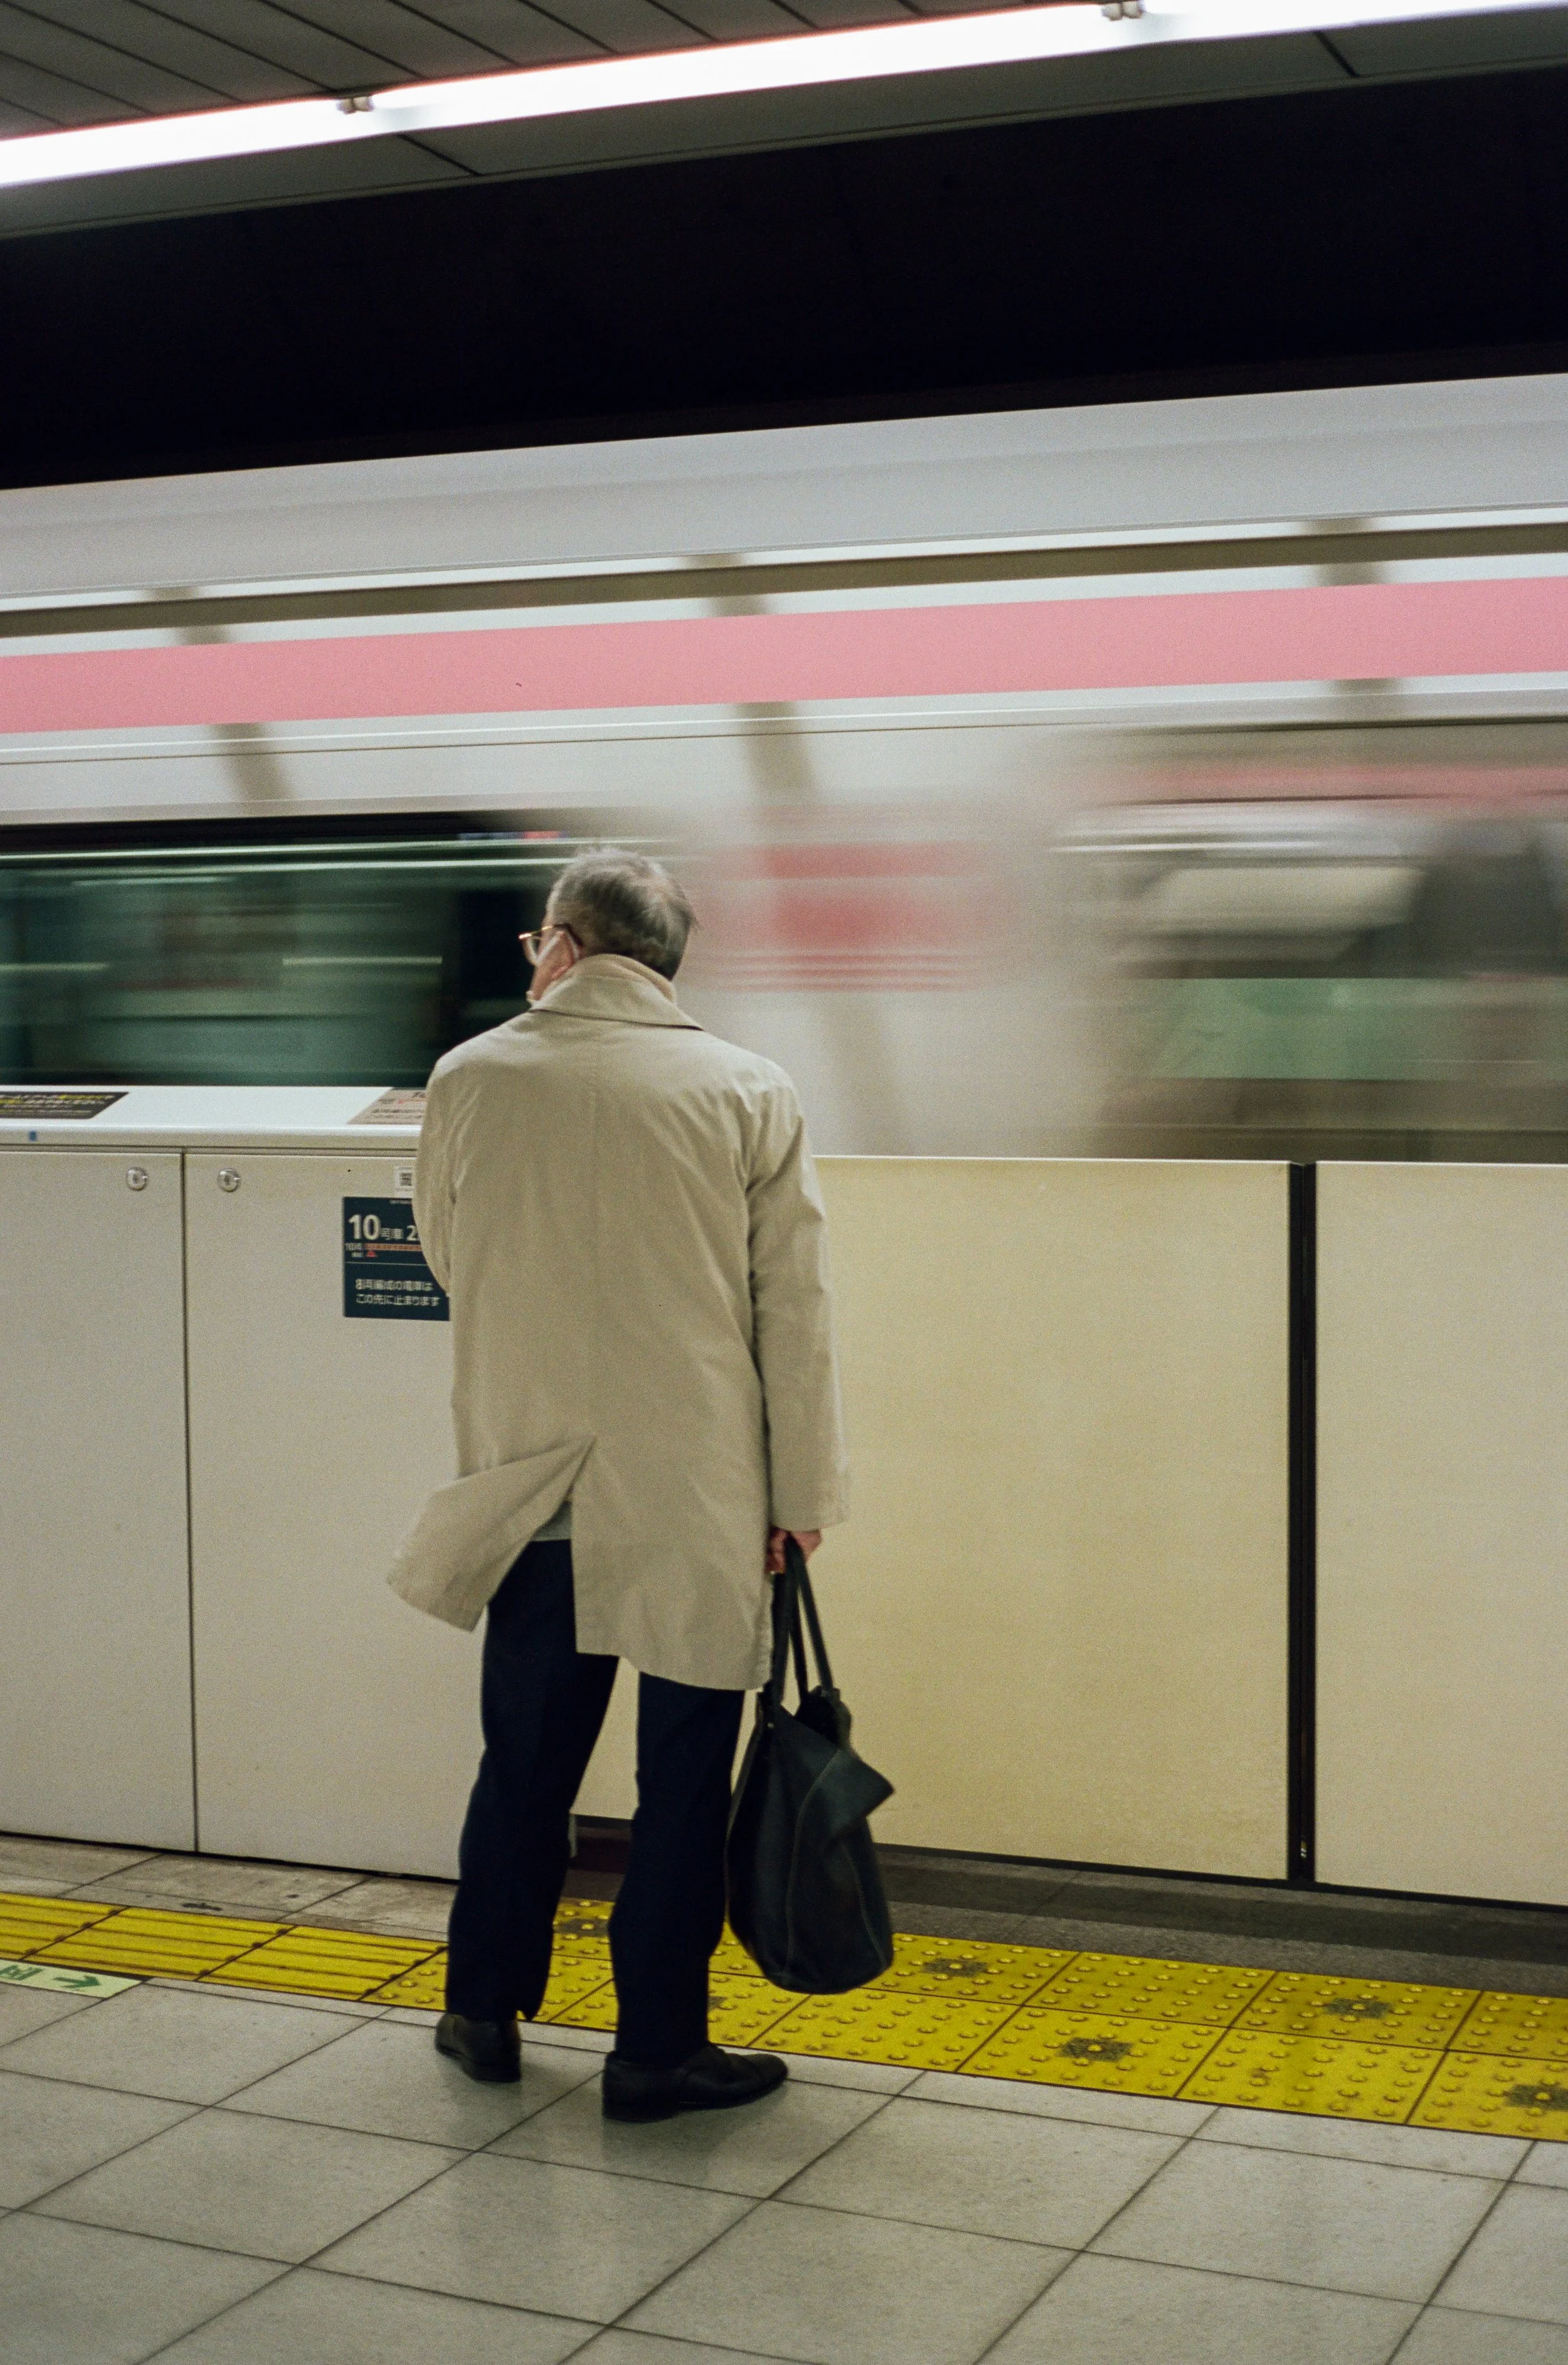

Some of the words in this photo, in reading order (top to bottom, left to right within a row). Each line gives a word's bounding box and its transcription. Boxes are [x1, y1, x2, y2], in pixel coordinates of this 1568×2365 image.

[356, 1294, 440, 1306] この先に止まります
